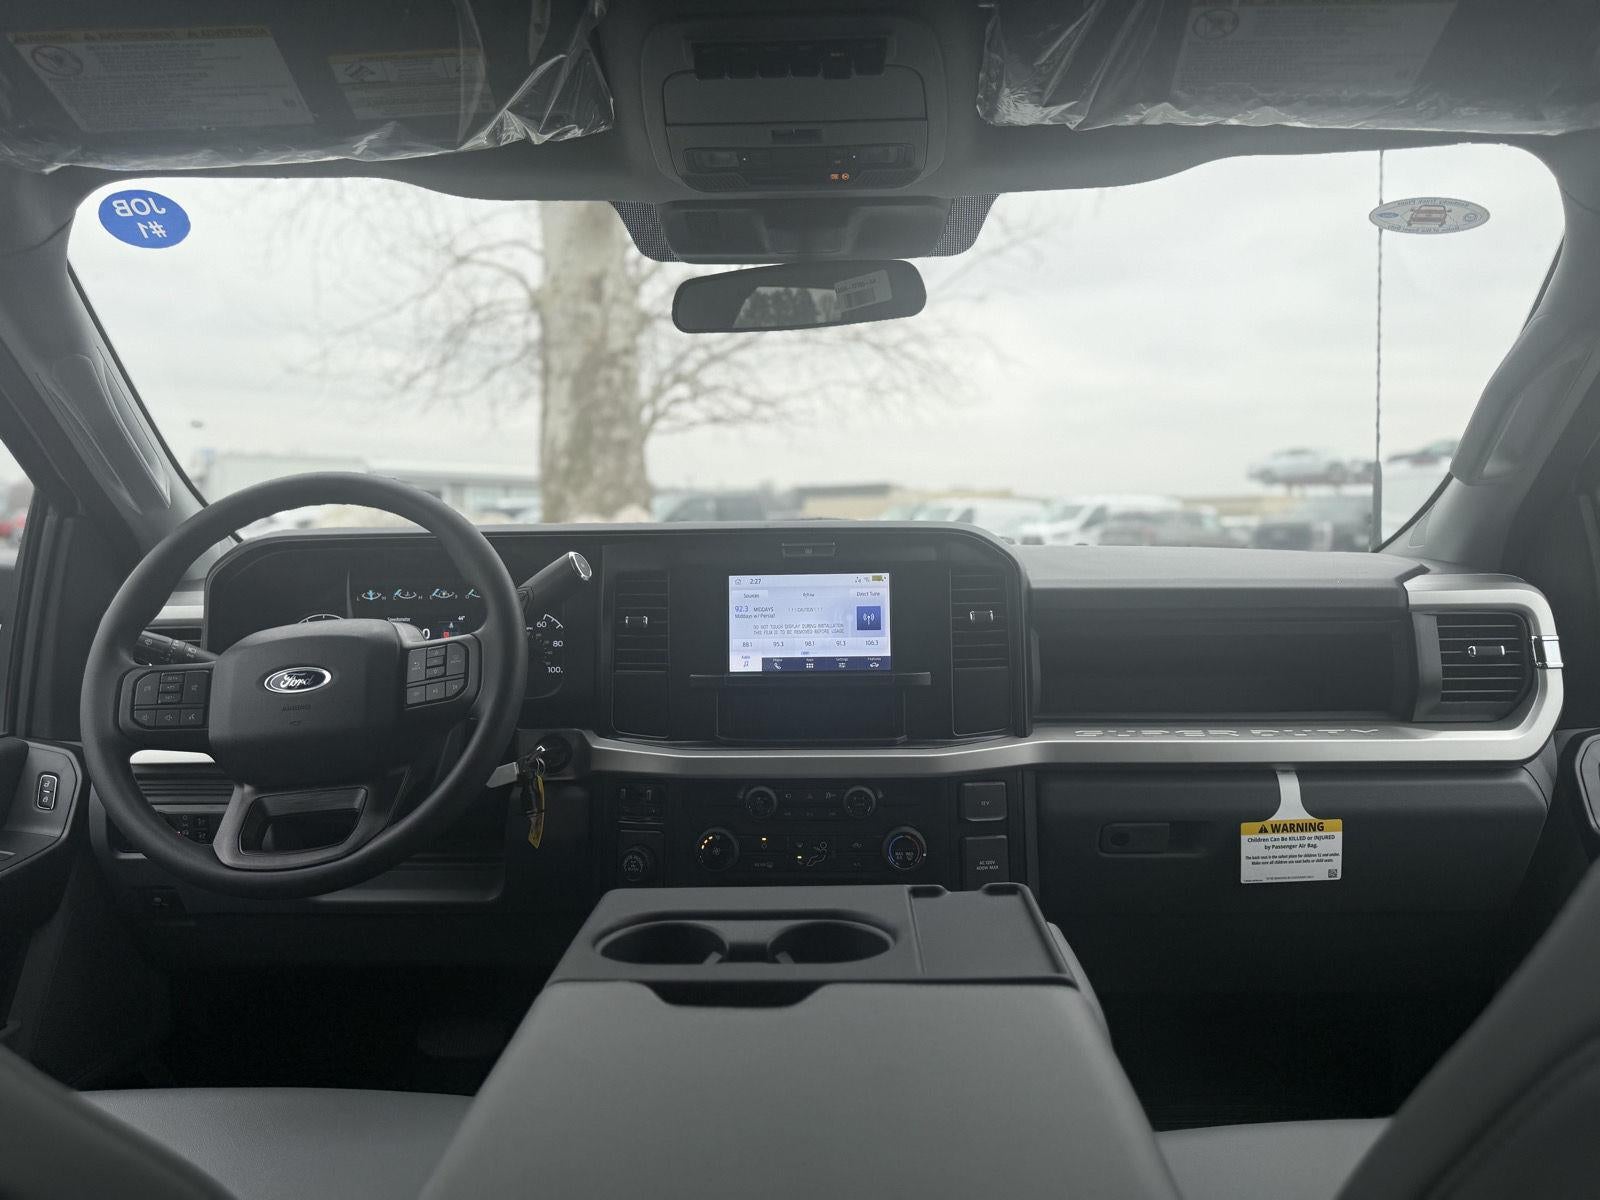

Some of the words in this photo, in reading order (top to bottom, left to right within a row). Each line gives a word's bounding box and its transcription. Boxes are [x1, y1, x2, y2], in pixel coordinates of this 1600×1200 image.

[536, 620, 547, 628] 60
[552, 640, 564, 648] 80
[1075, 729, 1241, 737] SUPER
[1250, 729, 1379, 737] DUTY
[1271, 822, 1325, 834] WARNING
